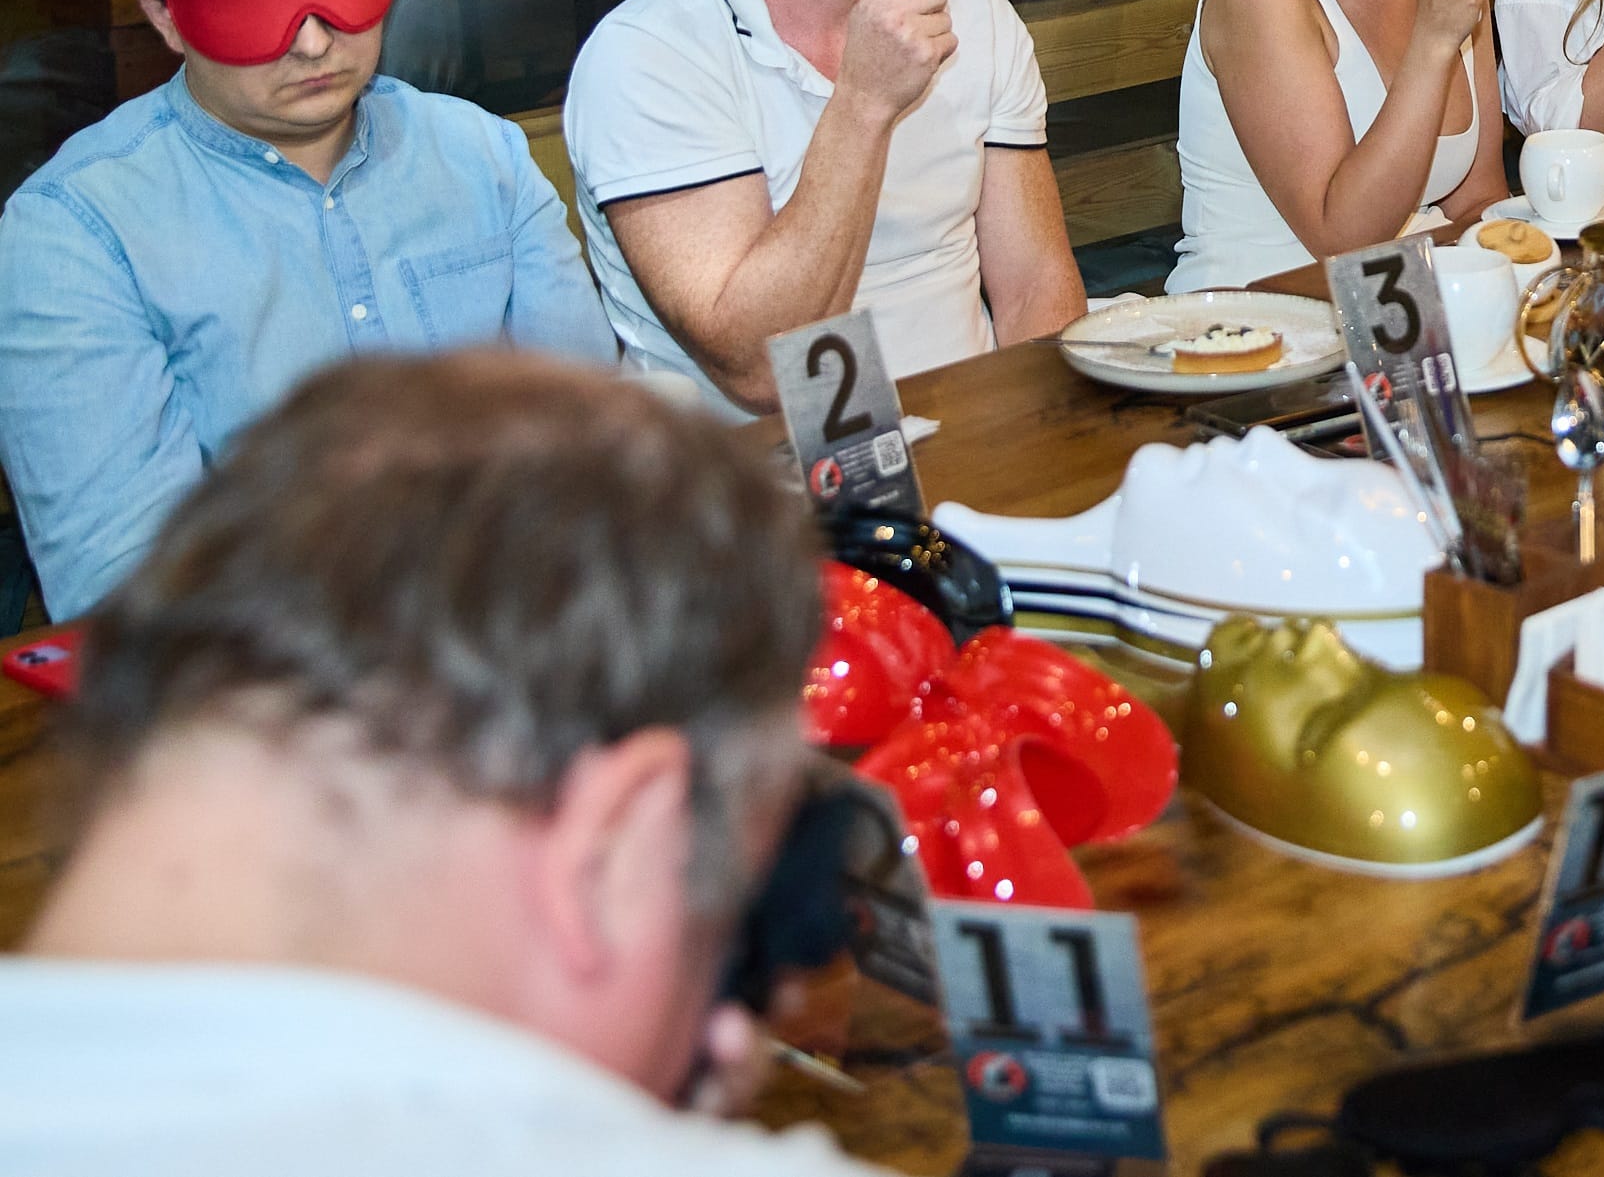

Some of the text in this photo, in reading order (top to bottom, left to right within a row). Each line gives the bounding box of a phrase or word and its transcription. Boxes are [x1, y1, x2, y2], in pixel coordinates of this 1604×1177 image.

[1362, 254, 1420, 354] 3
[807, 333, 872, 443] 2
[957, 920, 1136, 1049] 11
